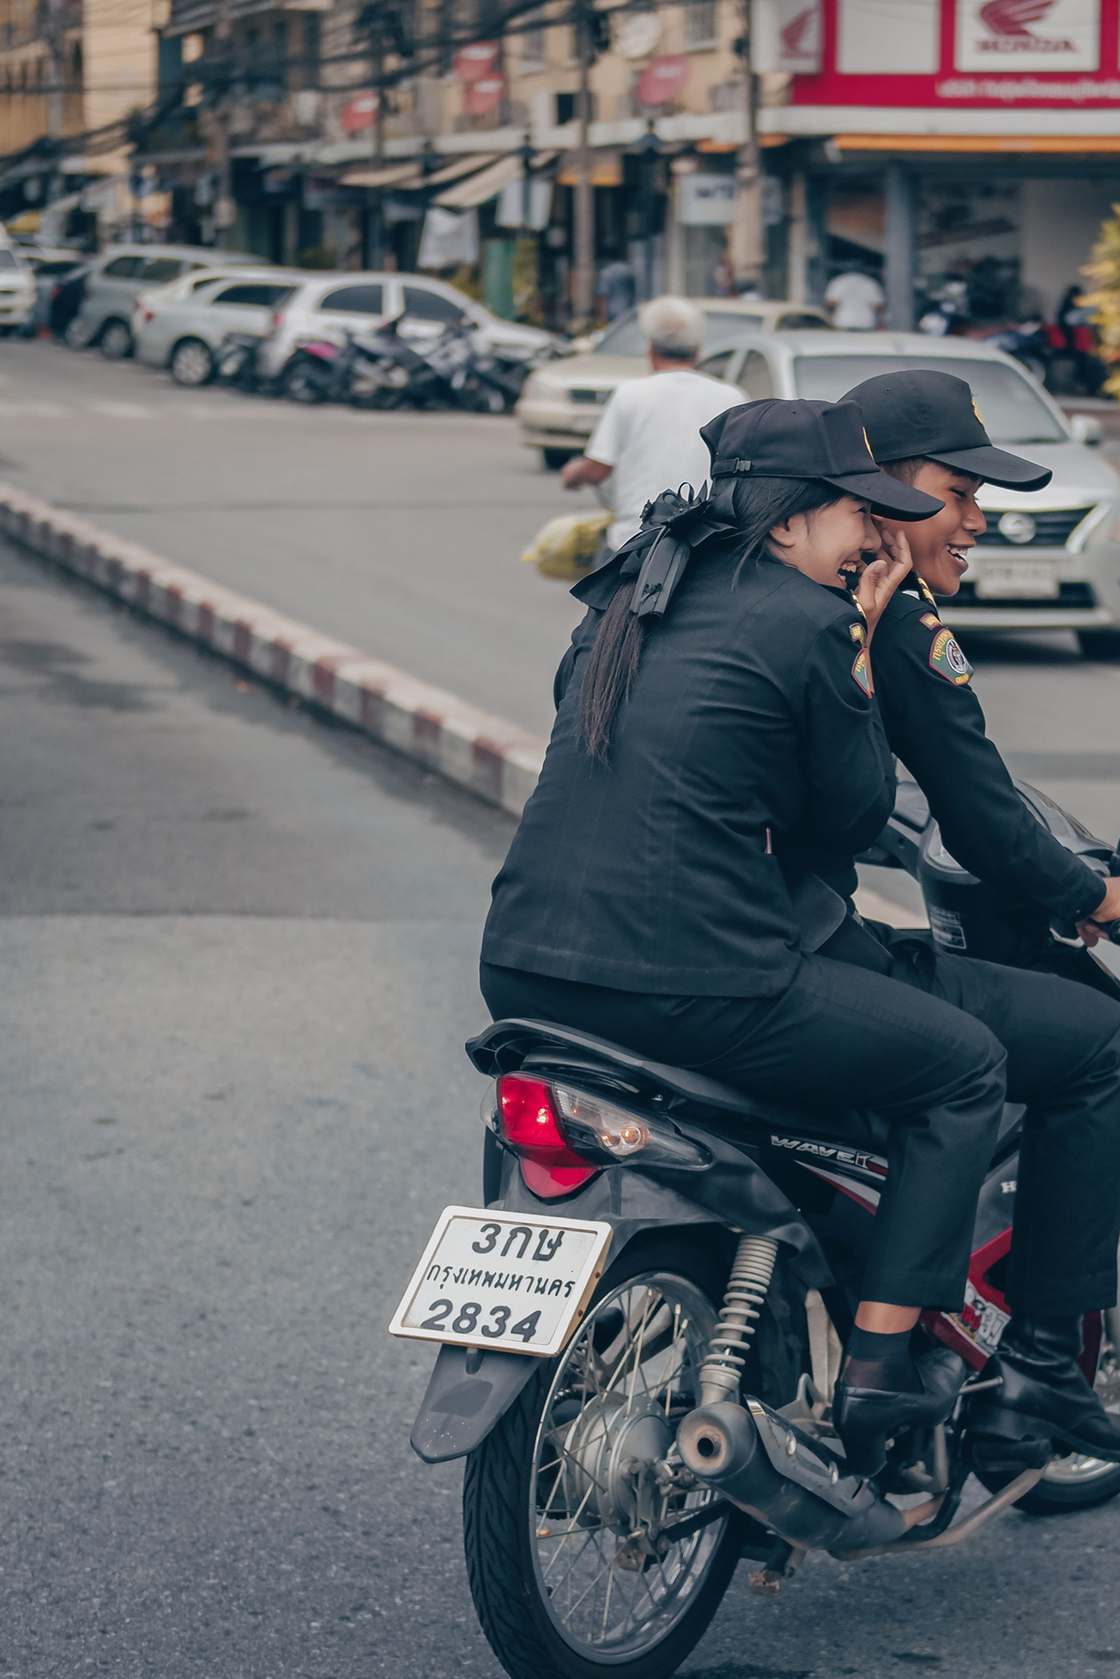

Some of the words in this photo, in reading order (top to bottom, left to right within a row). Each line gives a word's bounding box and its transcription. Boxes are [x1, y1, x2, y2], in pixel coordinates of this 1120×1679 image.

[770, 1135, 855, 1164] WAVE
[471, 1223, 565, 1262] 3กษ
[427, 1264, 576, 1298] กรุงเทพมหานคร
[420, 1298, 542, 1343] 2834
